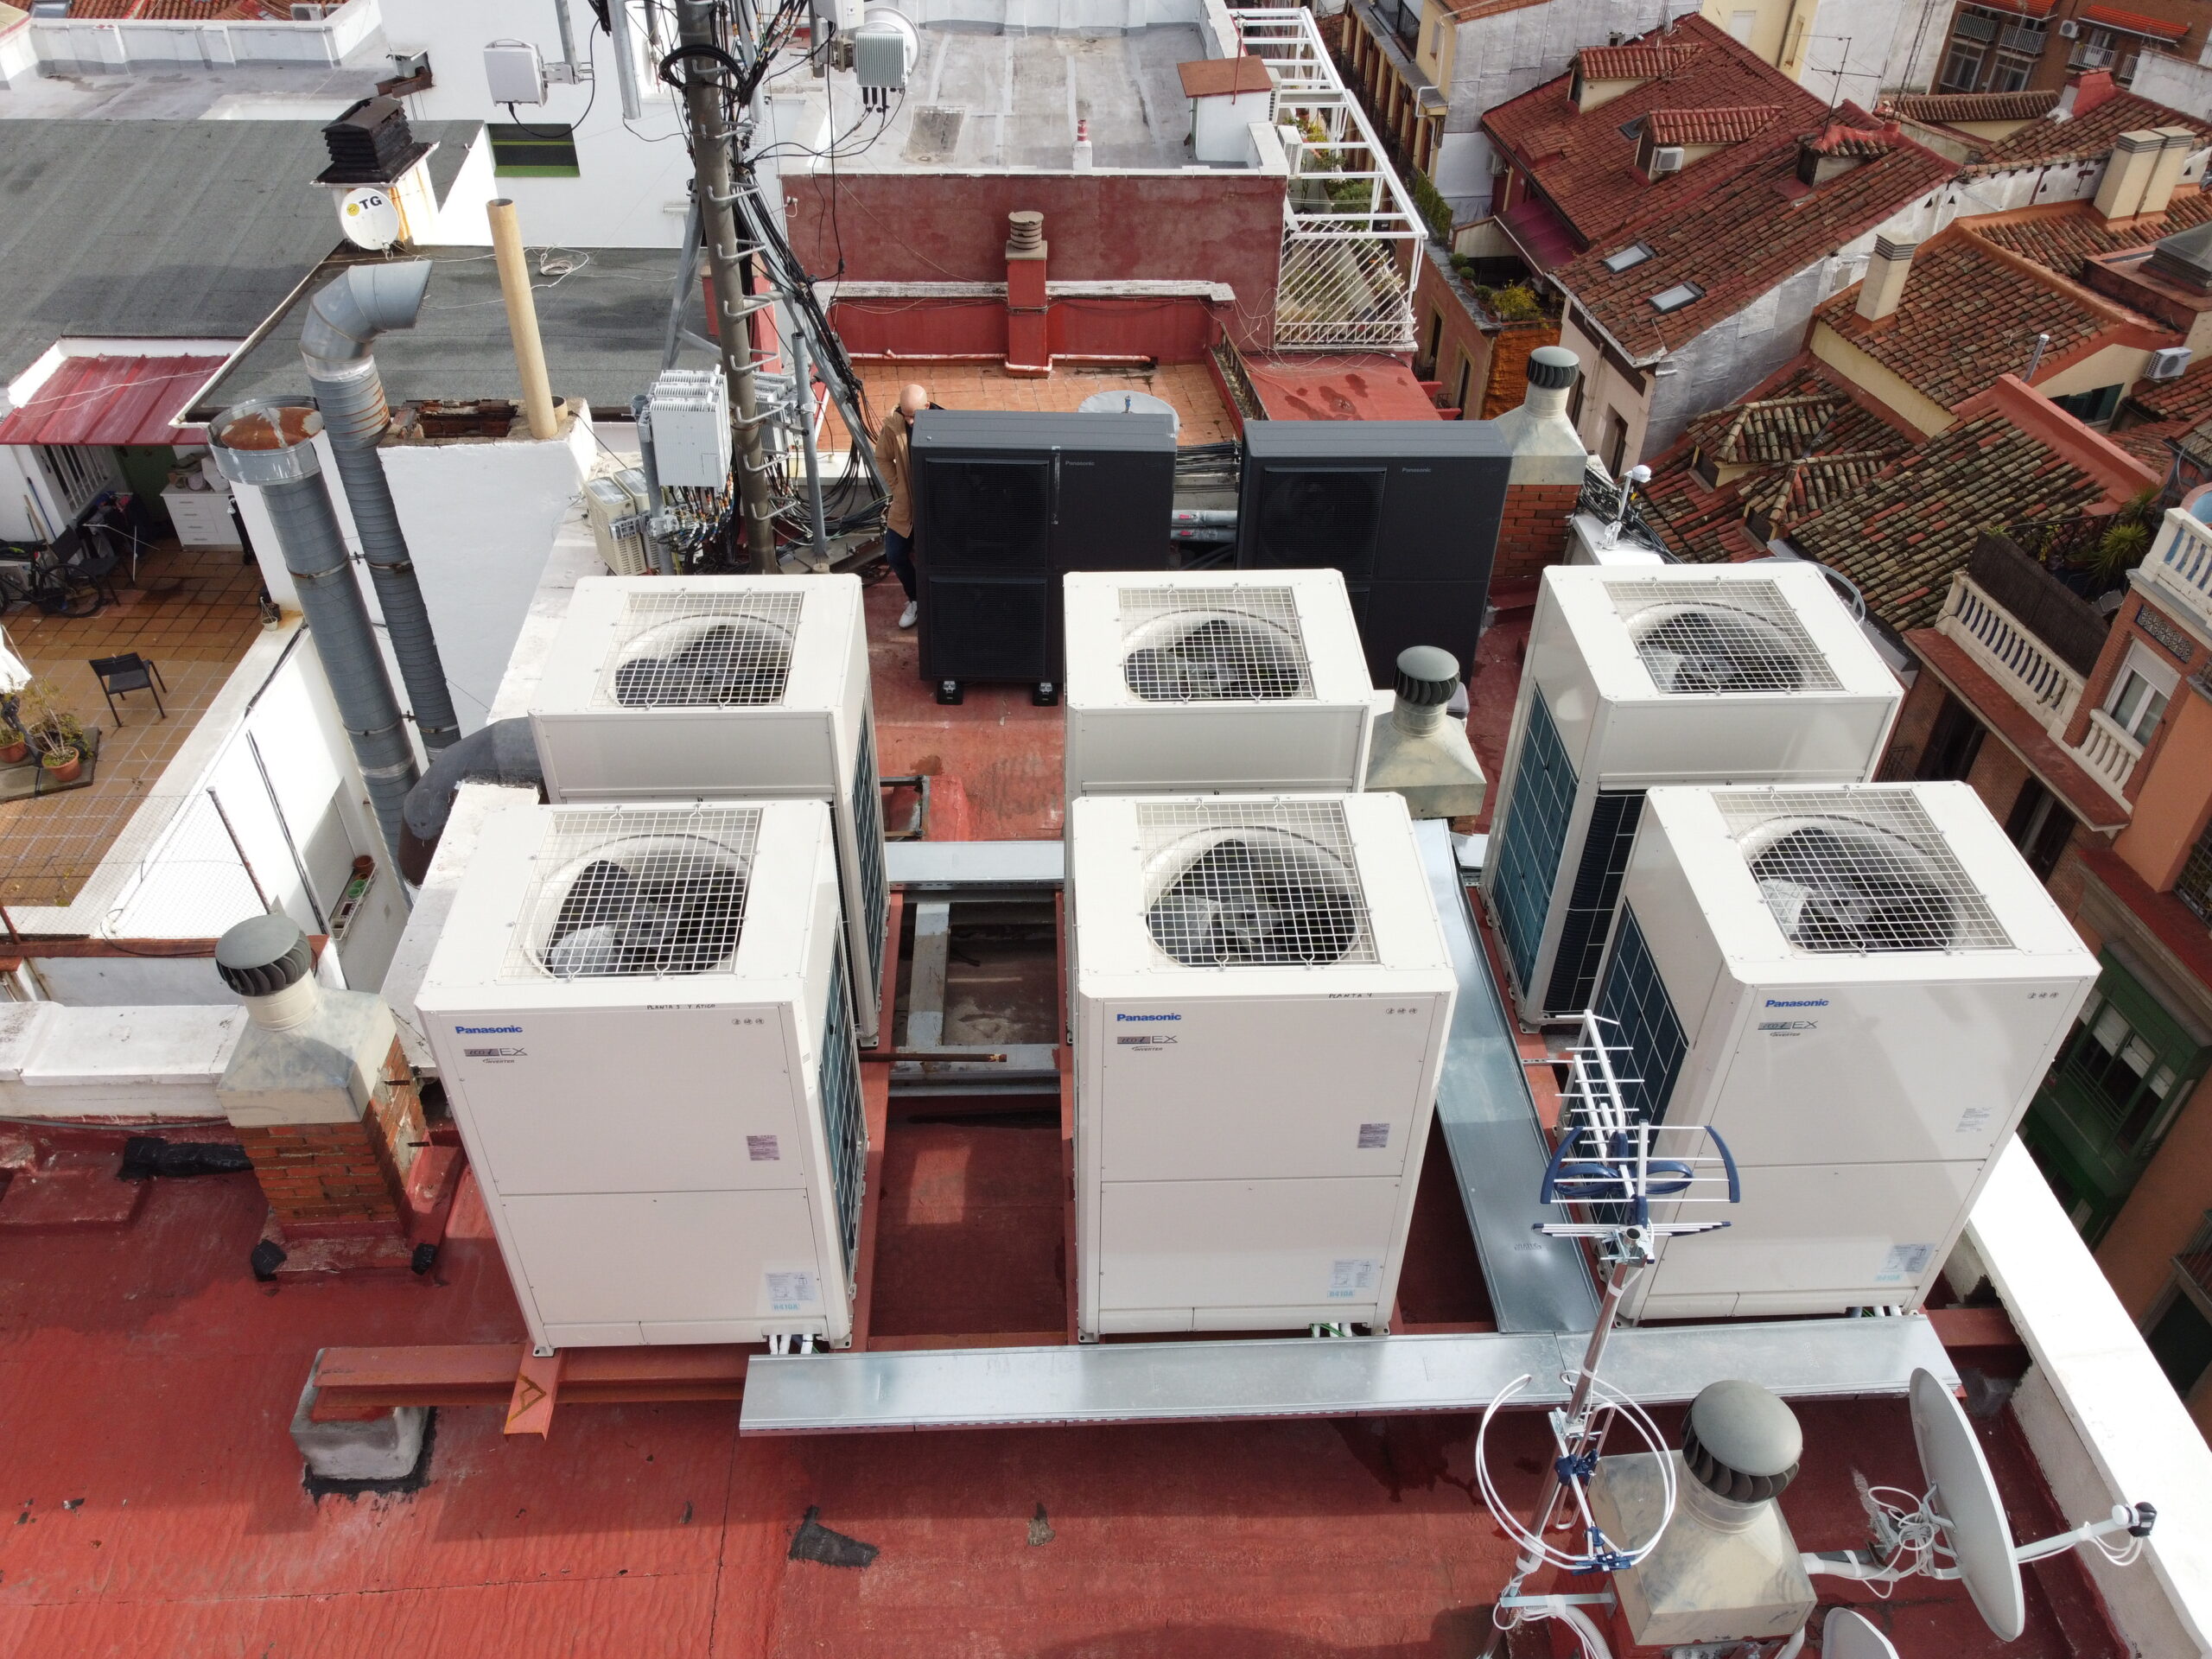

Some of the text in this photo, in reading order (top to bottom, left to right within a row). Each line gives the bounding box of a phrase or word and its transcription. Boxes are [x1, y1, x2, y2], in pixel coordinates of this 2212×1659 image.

[359, 195, 383, 210] TG
[1764, 999, 1830, 1007] Panasonic
[1116, 1013, 1182, 1021] Panasonic
[454, 1025, 524, 1034] Panasonic
